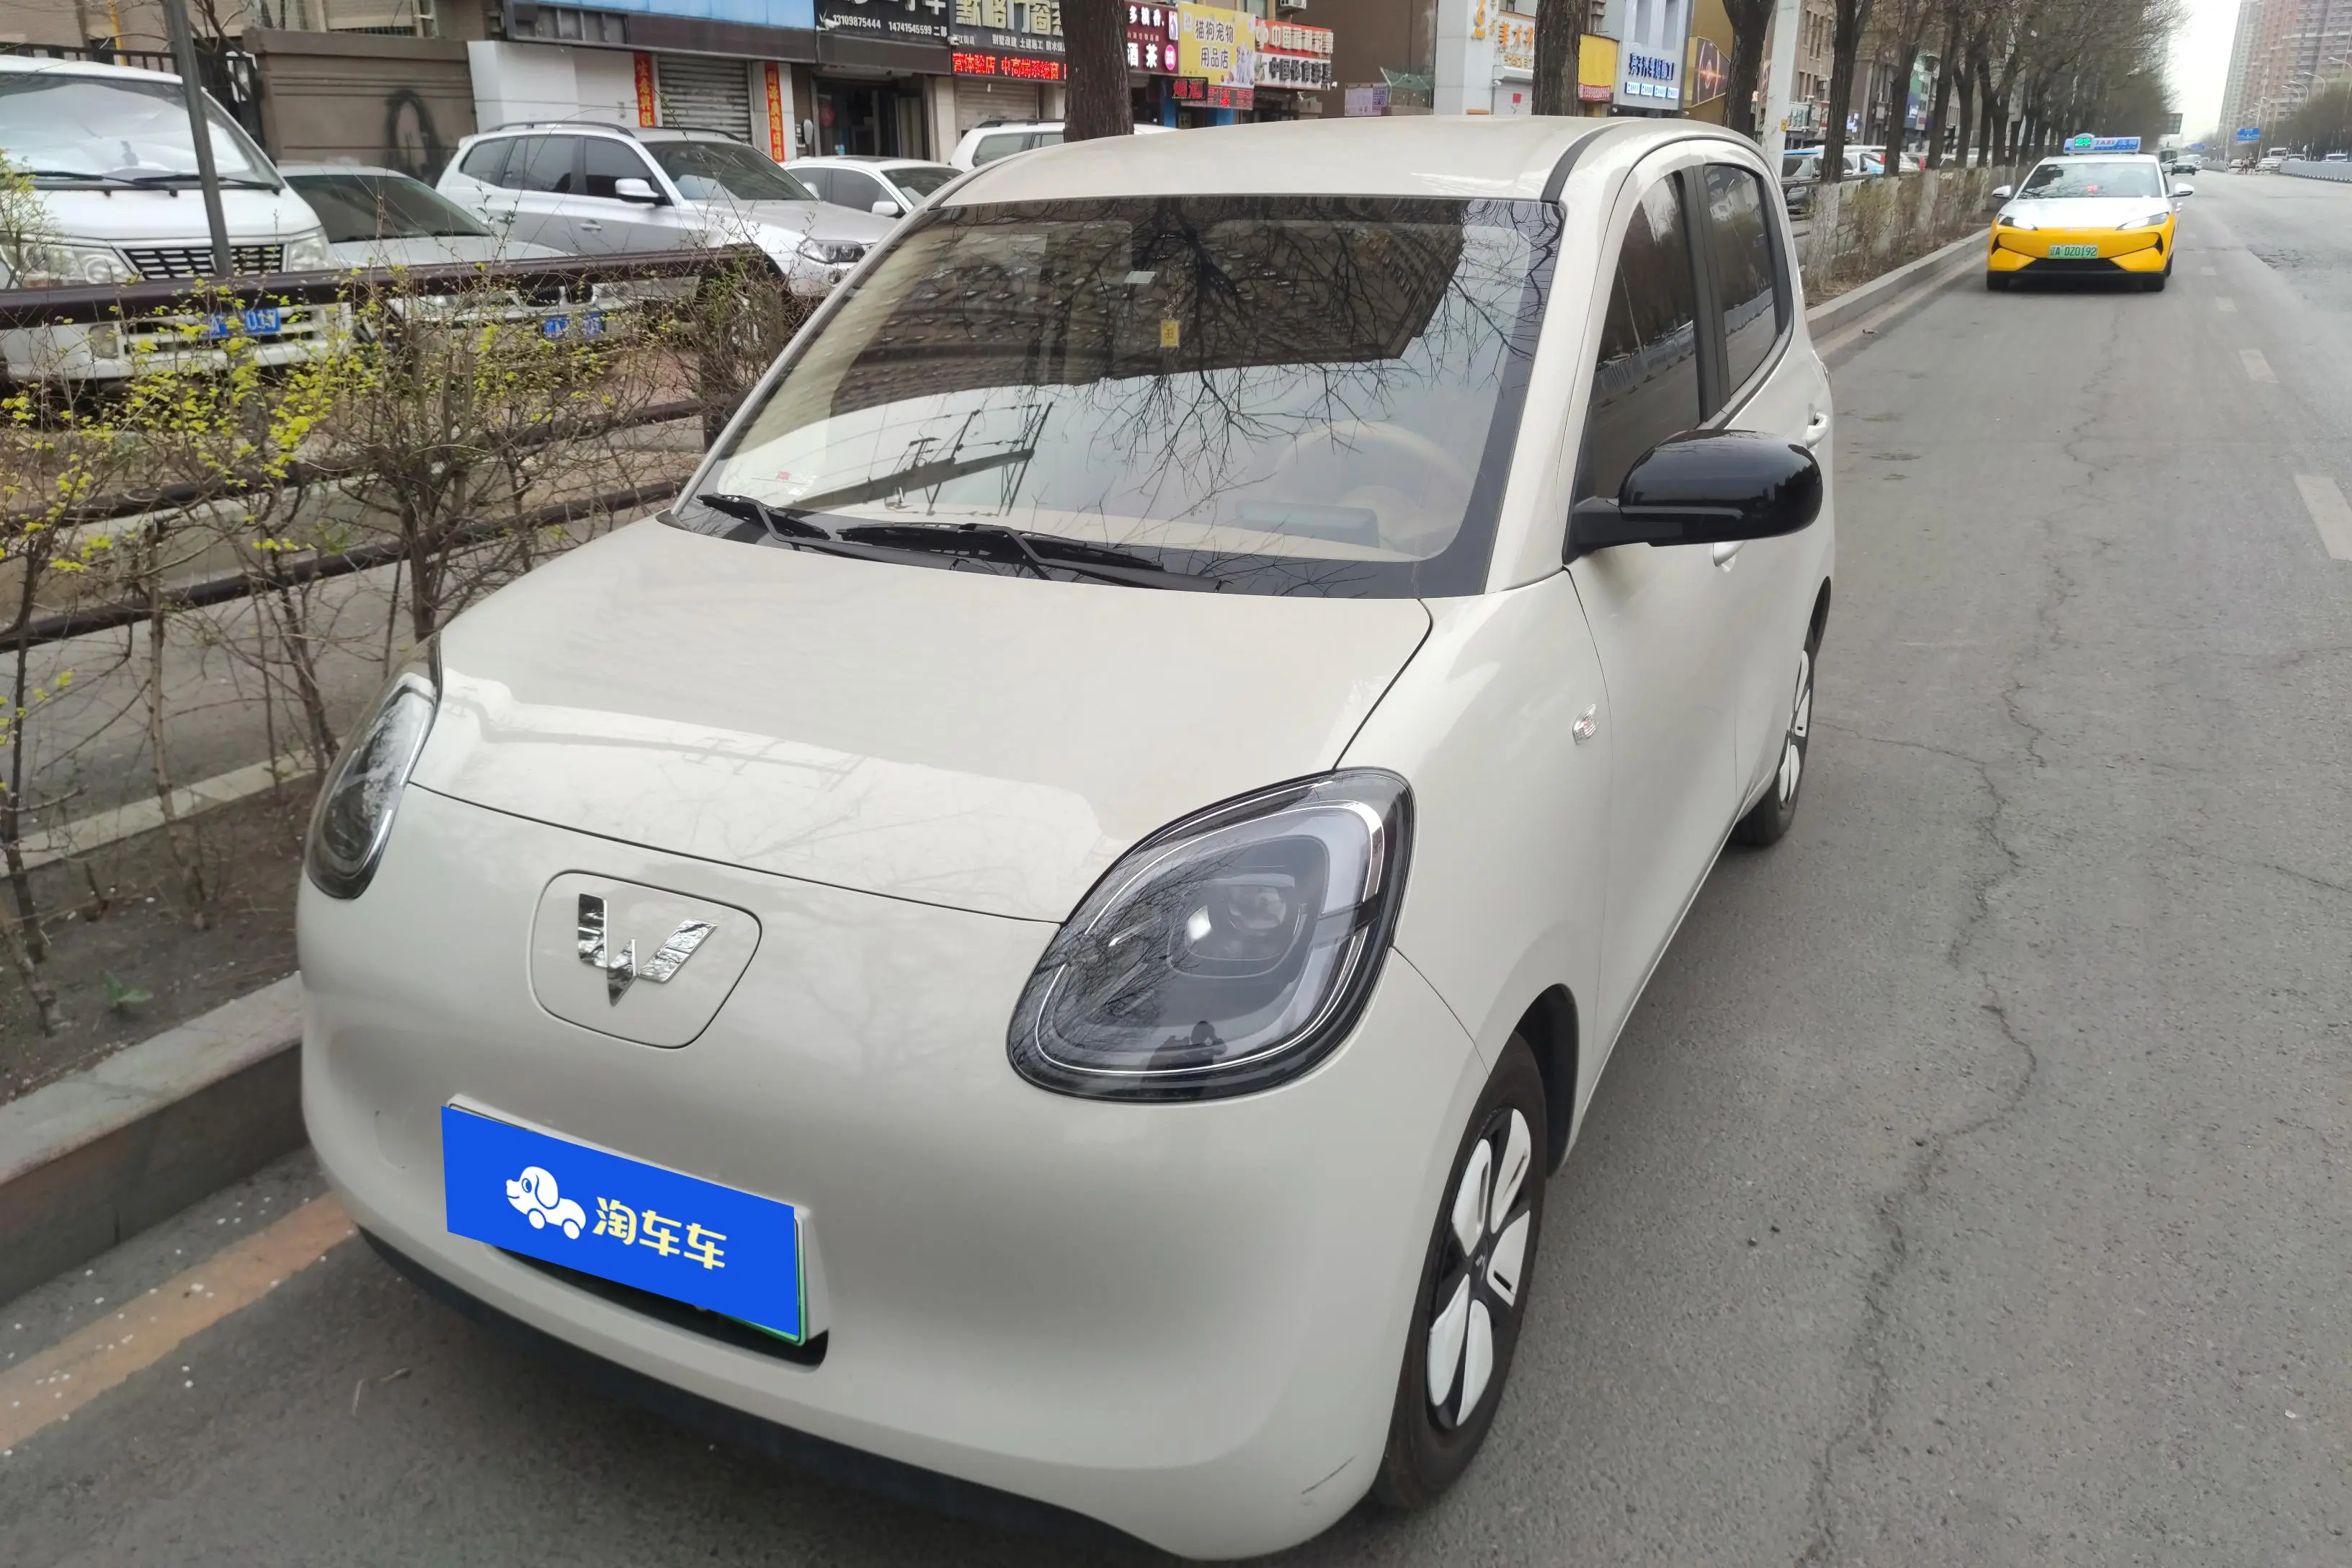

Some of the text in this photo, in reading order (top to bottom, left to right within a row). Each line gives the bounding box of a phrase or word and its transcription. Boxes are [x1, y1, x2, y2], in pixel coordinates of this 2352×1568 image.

[1195, 19, 1234, 43] 猫狗宠物
[1200, 47, 1229, 69] 用品店
